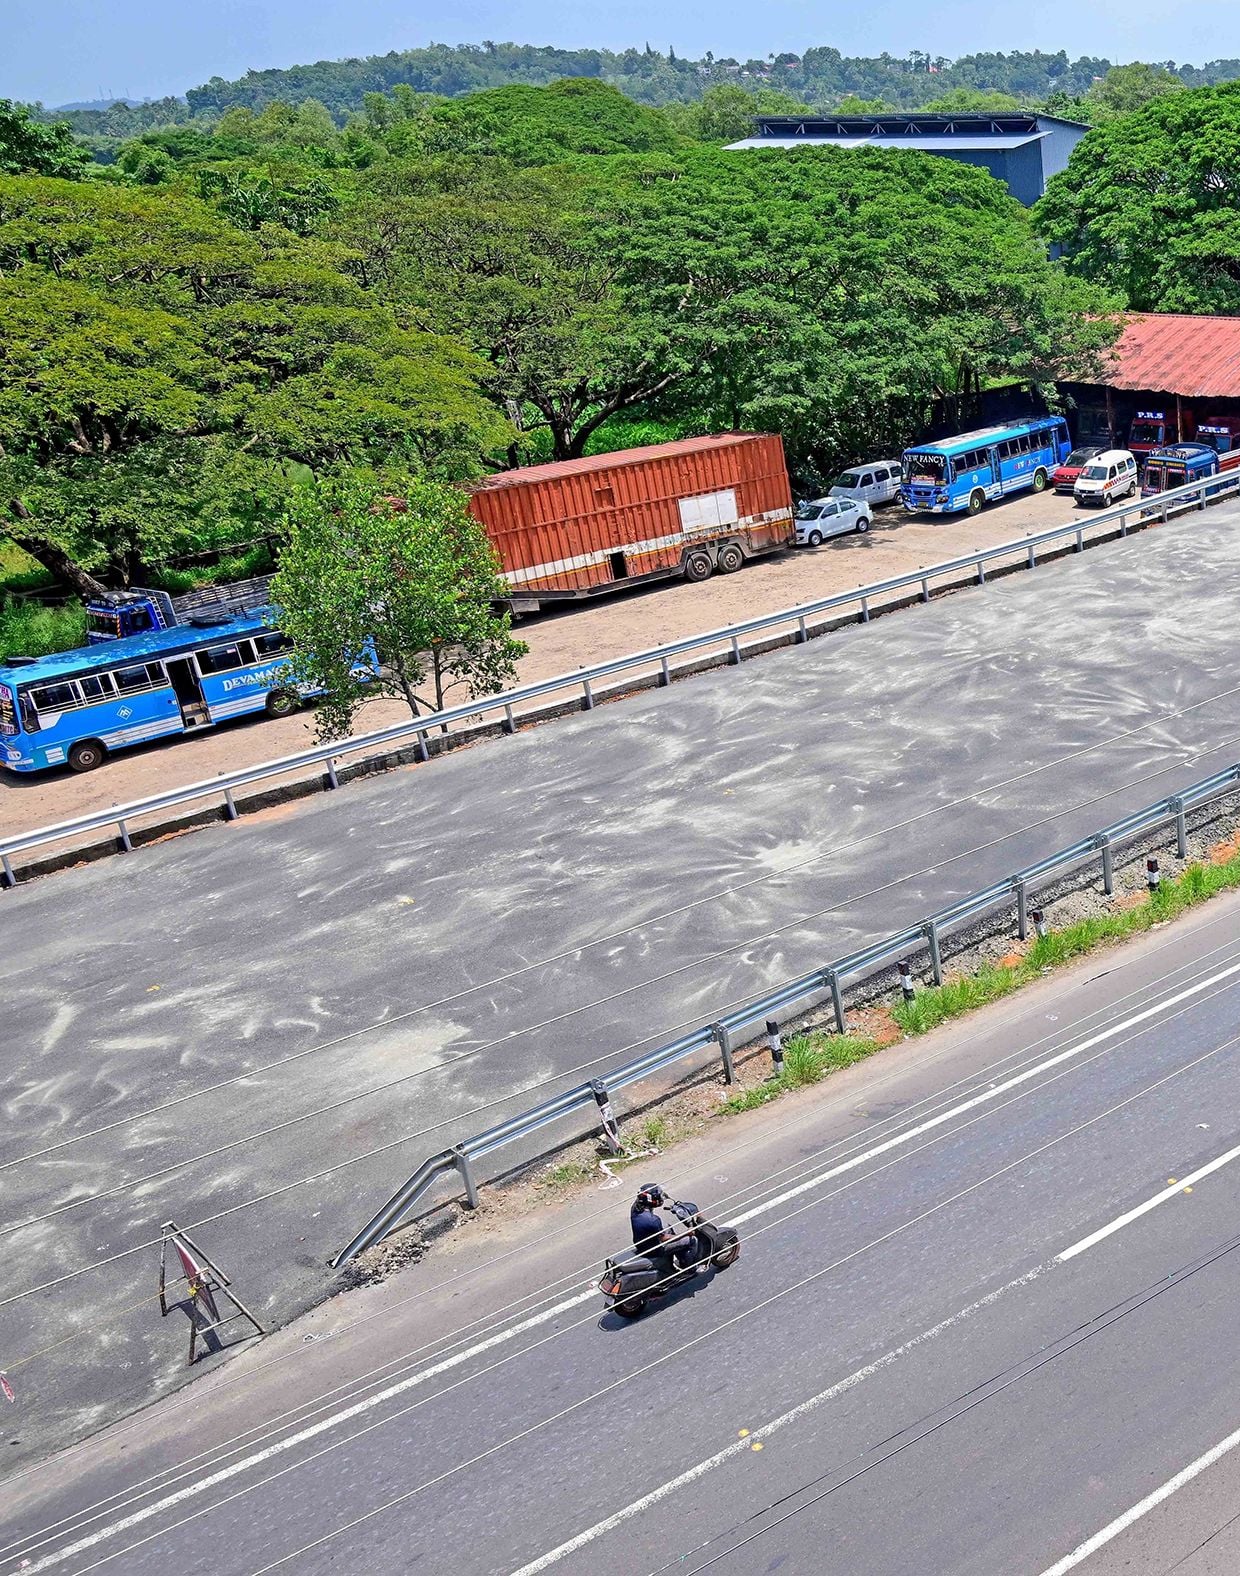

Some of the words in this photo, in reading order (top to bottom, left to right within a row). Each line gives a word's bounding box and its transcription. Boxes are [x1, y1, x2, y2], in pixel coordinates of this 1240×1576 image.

[1137, 411, 1164, 419] P.R.S
[1198, 425, 1229, 434] P.R.S
[903, 454, 919, 462] NEW
[919, 455, 945, 464] FANCY
